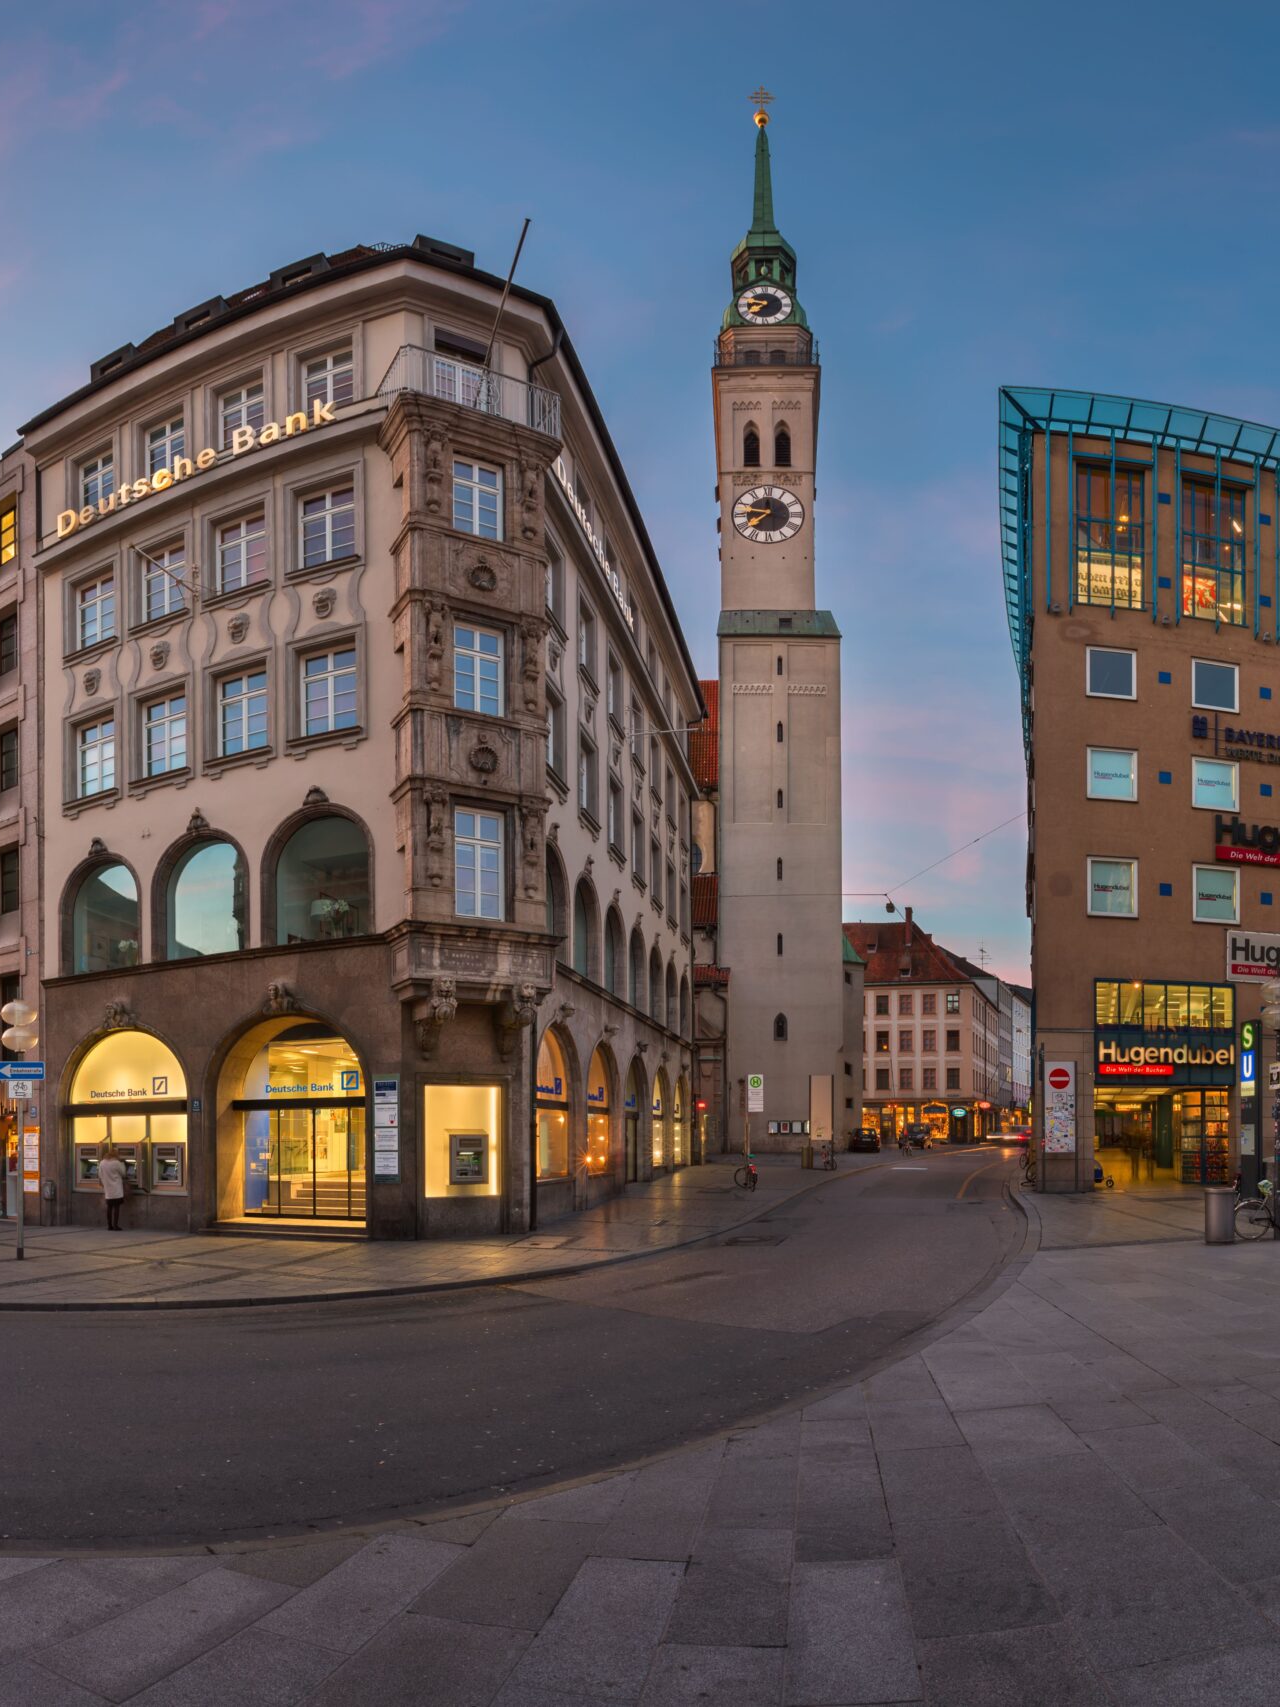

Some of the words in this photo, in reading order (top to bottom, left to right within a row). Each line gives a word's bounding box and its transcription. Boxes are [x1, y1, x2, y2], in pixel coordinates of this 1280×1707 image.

[56, 447, 220, 540] Deutsche
[232, 398, 337, 457] Bank
[557, 456, 612, 581] Deutsche
[612, 574, 635, 634] Bank
[1094, 771, 1130, 779] Hugendubel
[1197, 777, 1231, 787] Hugendubel
[1230, 851, 1244, 859] Die
[1245, 852, 1263, 861] Welt
[1264, 855, 1278, 863] der
[1094, 883, 1130, 891] Hugendubel
[1198, 892, 1232, 901] Hugendubel
[1231, 937, 1280, 969] Hug
[1238, 966, 1250, 974] Die
[1250, 967, 1267, 975] Welt
[1243, 1024, 1253, 1049] S
[1098, 1040, 1235, 1067] Hugendubel
[1243, 1054, 1253, 1078] U
[90, 1090, 125, 1099] Deutsche
[127, 1087, 148, 1097] Bank
[265, 1083, 308, 1094] Deutsche
[310, 1082, 335, 1092] Bank
